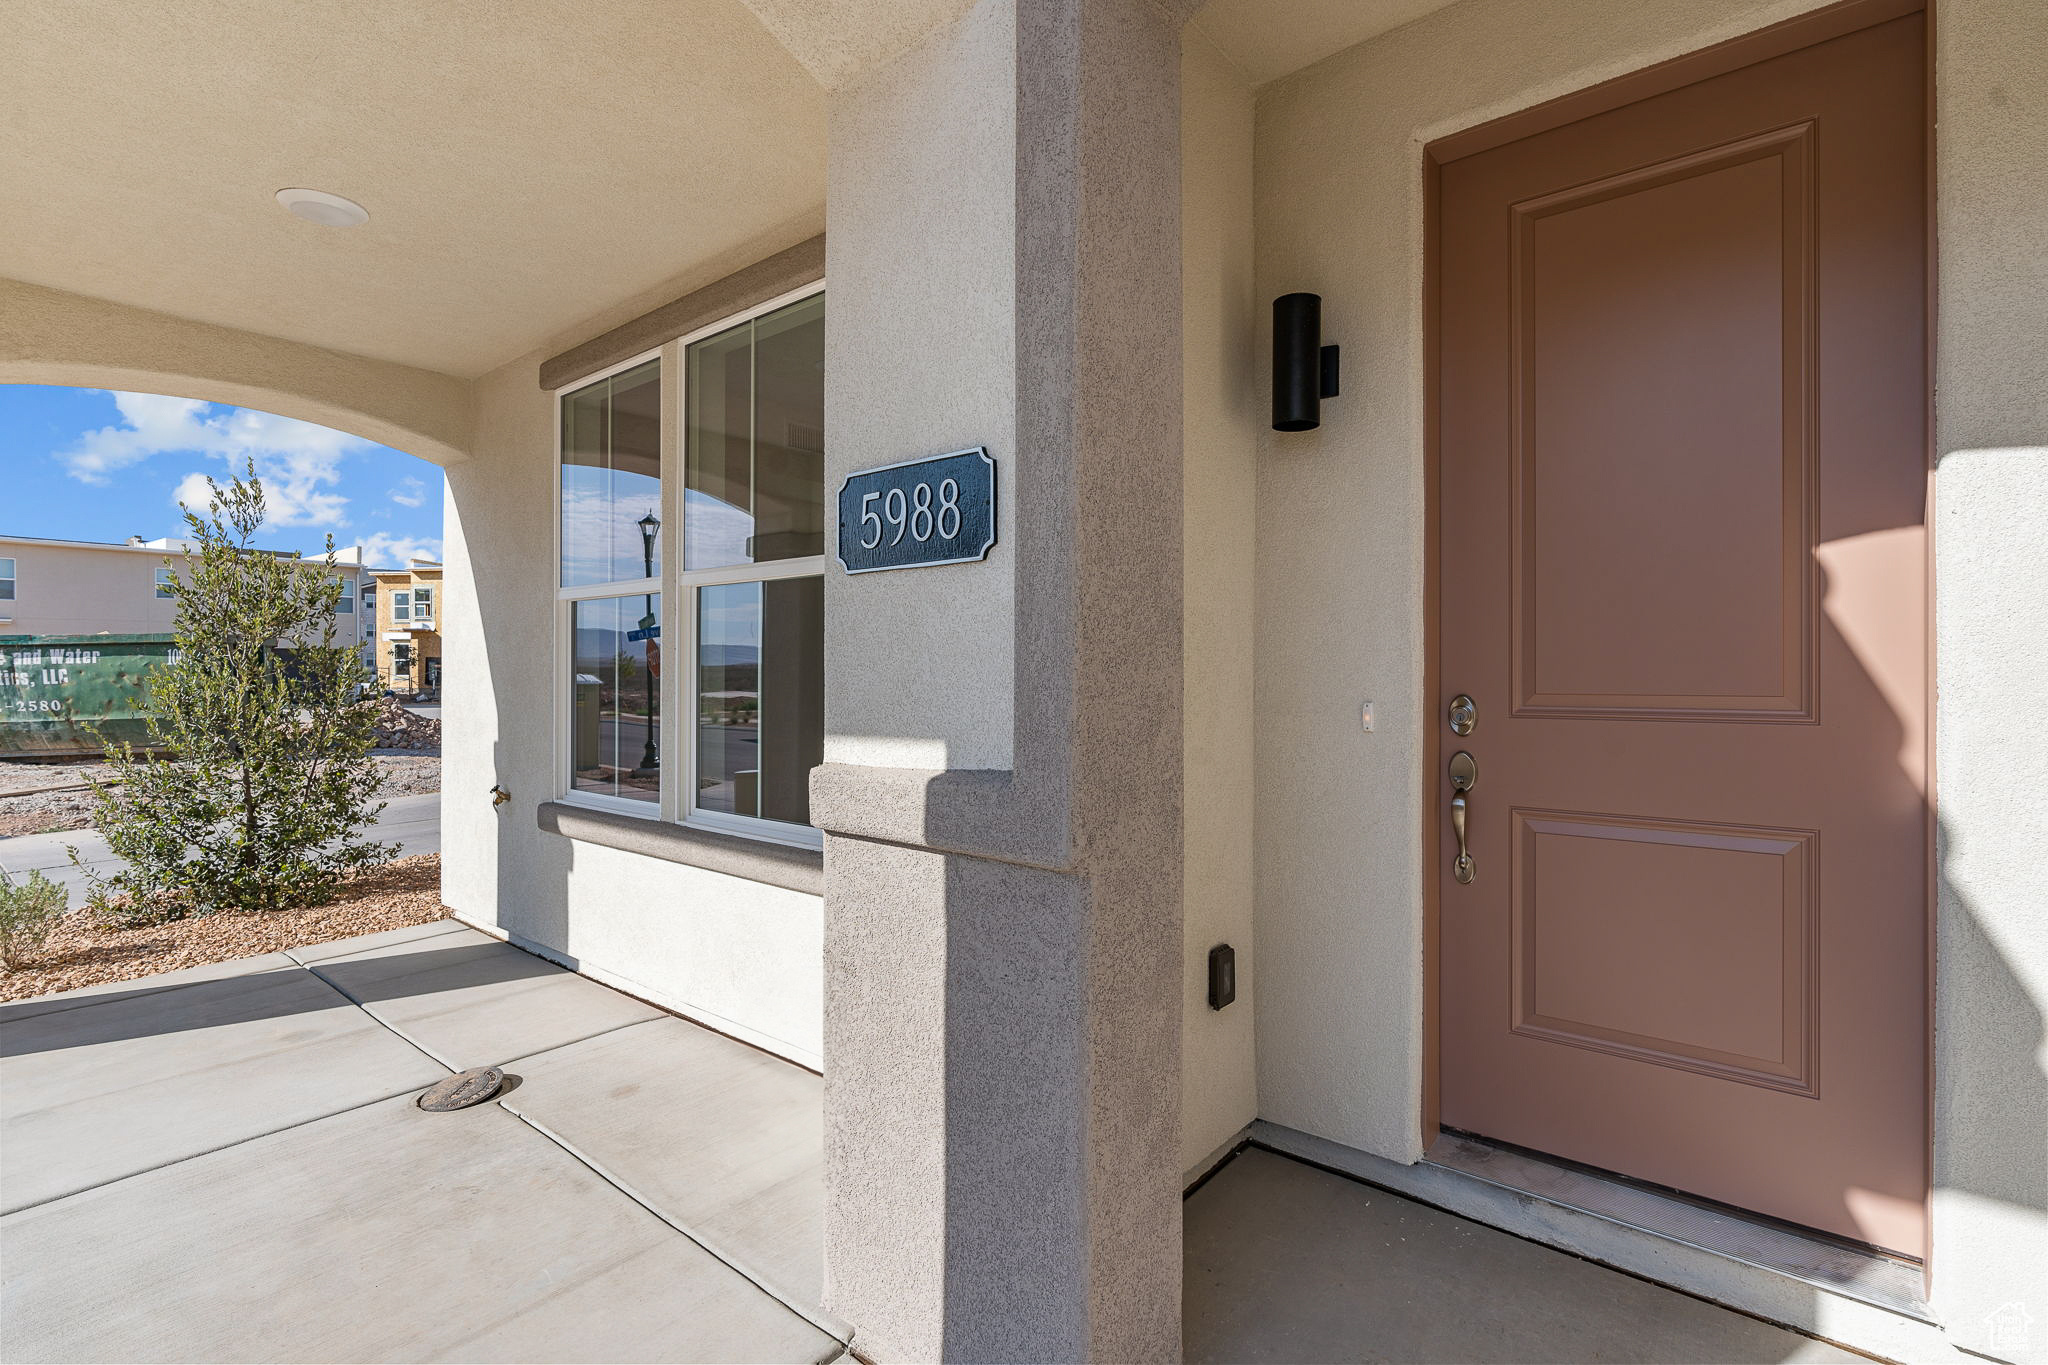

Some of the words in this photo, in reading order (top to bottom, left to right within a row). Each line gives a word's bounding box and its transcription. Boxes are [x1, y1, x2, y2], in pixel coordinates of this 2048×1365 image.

[860, 478, 961, 549] 5988
[13, 648, 42, 665] and
[50, 648, 100, 665] Water
[42, 668, 69, 685] LLC
[0, 700, 62, 712] -2580
